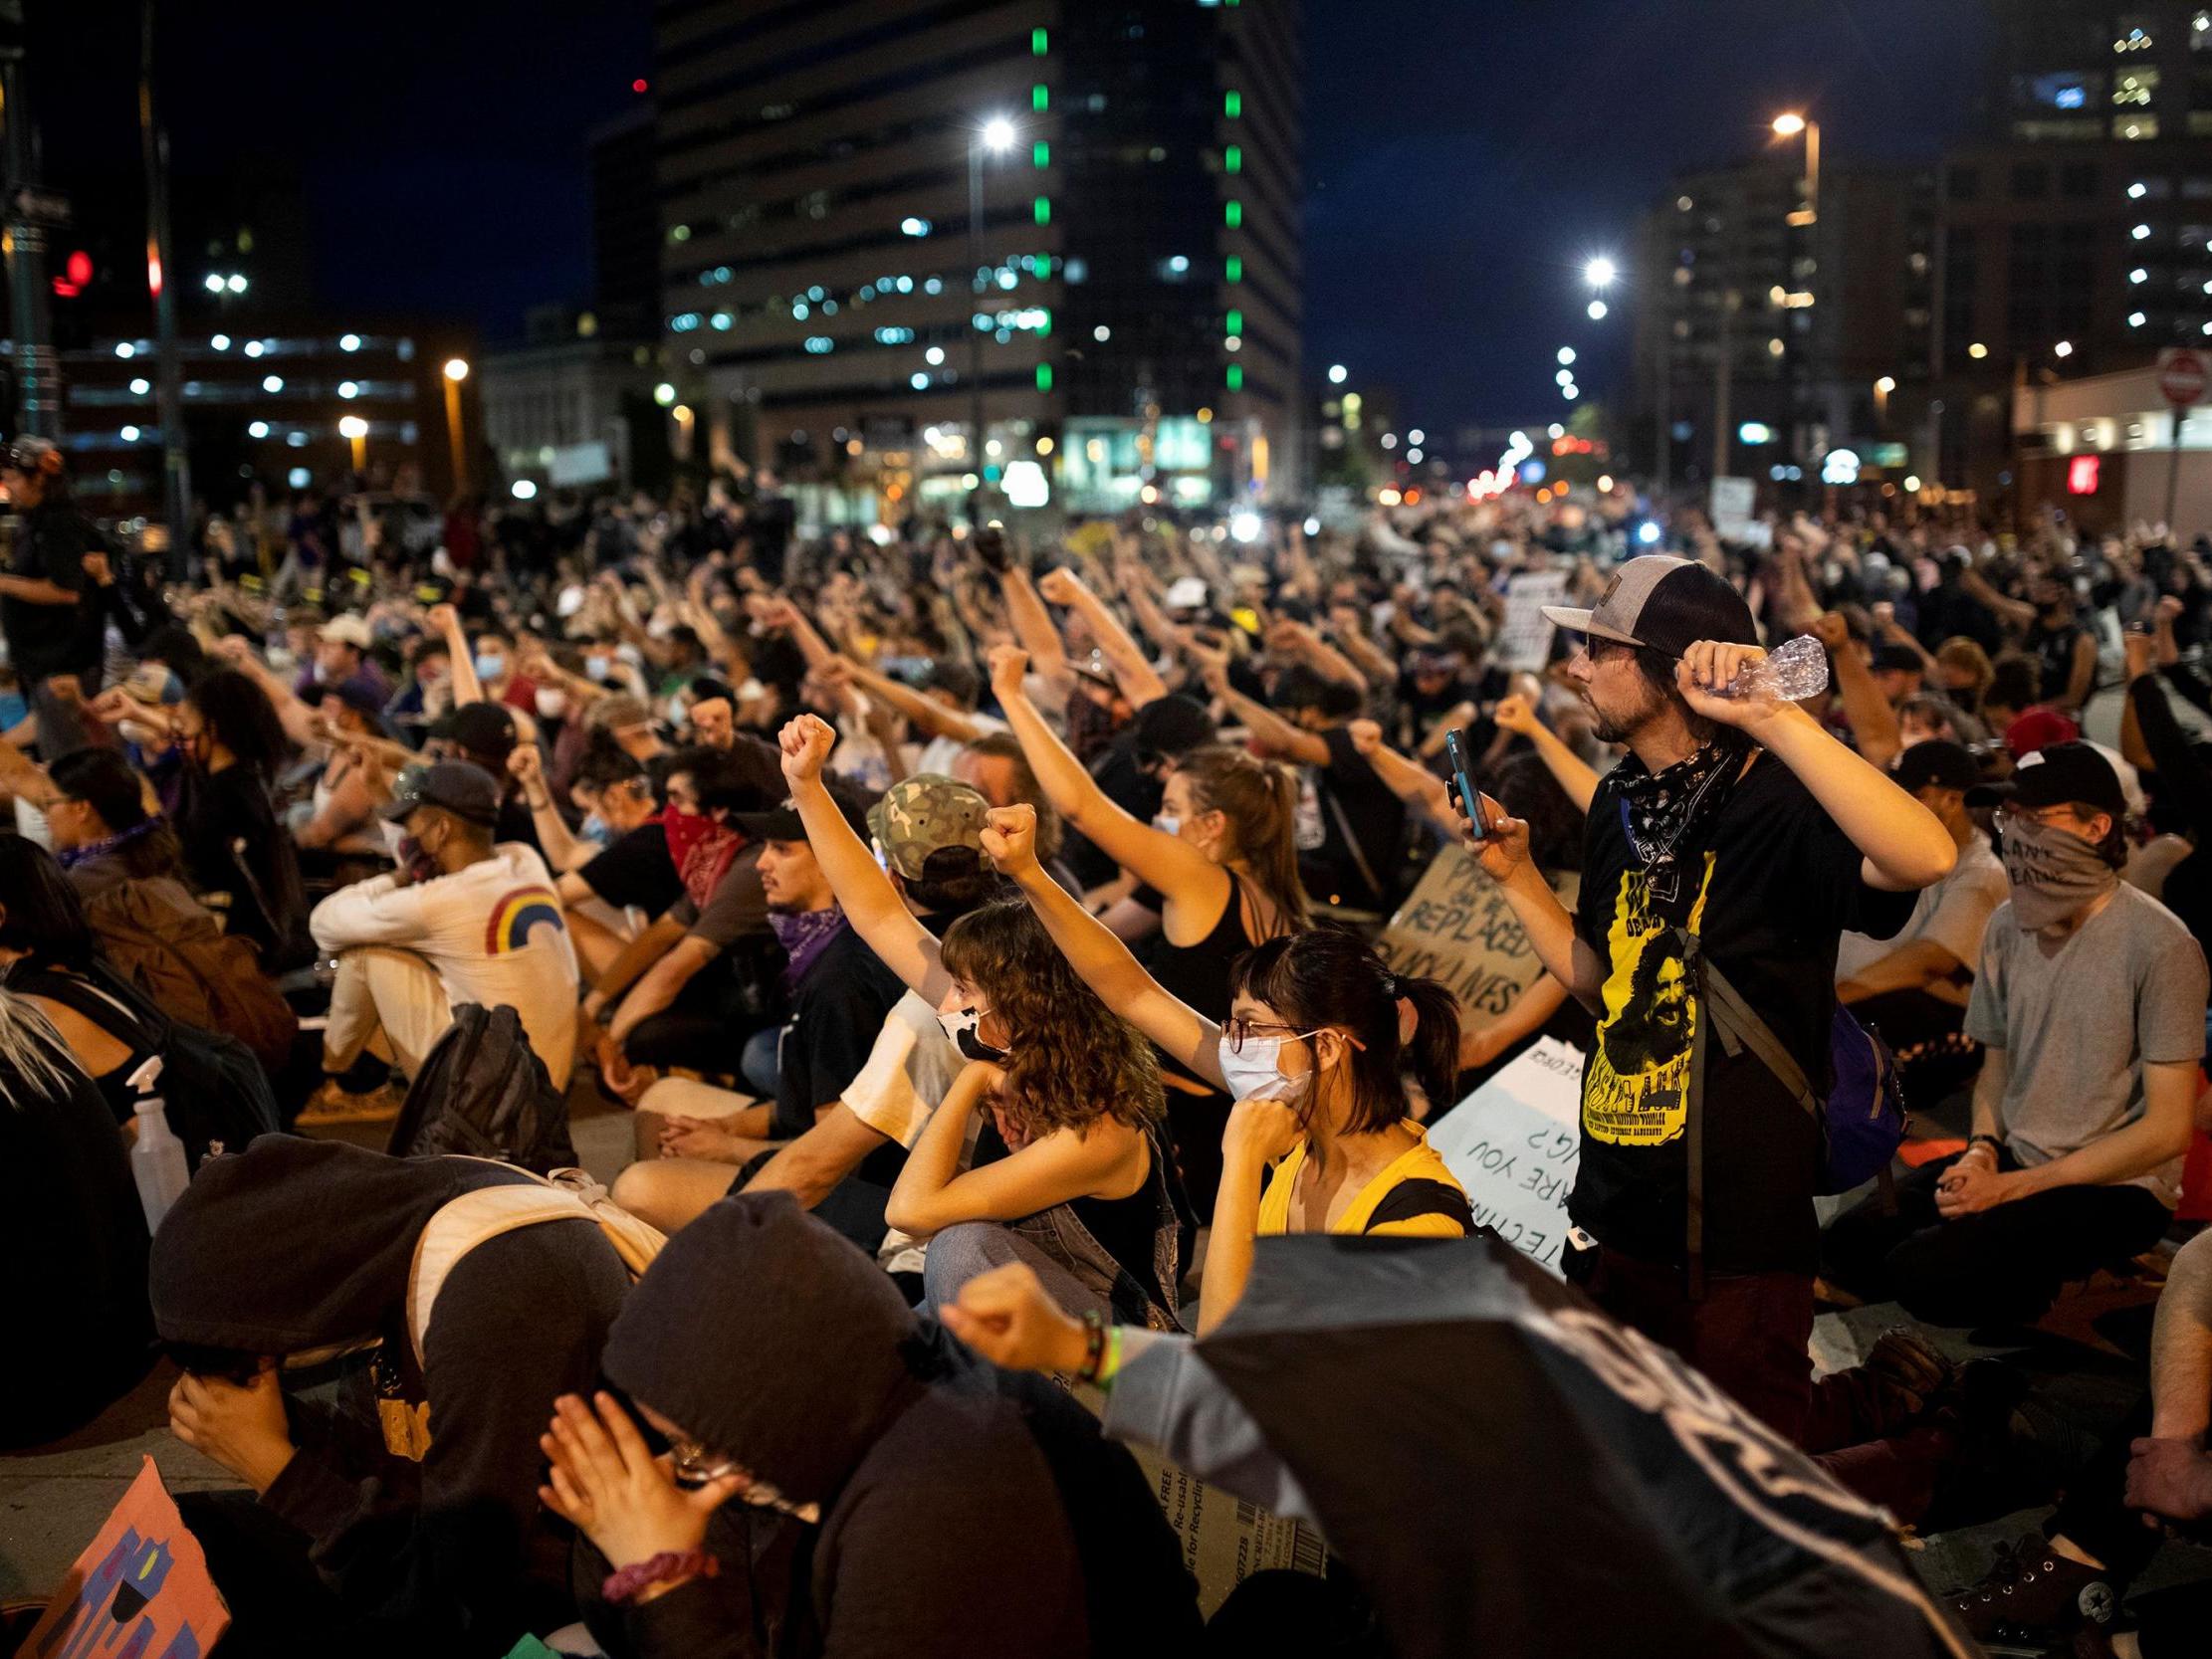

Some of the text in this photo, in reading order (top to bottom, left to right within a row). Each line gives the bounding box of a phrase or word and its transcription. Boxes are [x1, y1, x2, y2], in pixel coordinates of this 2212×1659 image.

[1405, 900, 1530, 958] REPLACED
[1466, 1141, 1570, 1210] ARE YOU
[1469, 1198, 1559, 1267] TECTIN
[1161, 1469, 1172, 1503] FREE
[1175, 1471, 1188, 1530] Re-usabl
[1190, 1479, 1204, 1534] Recyclin
[1187, 1535, 1198, 1555] for
